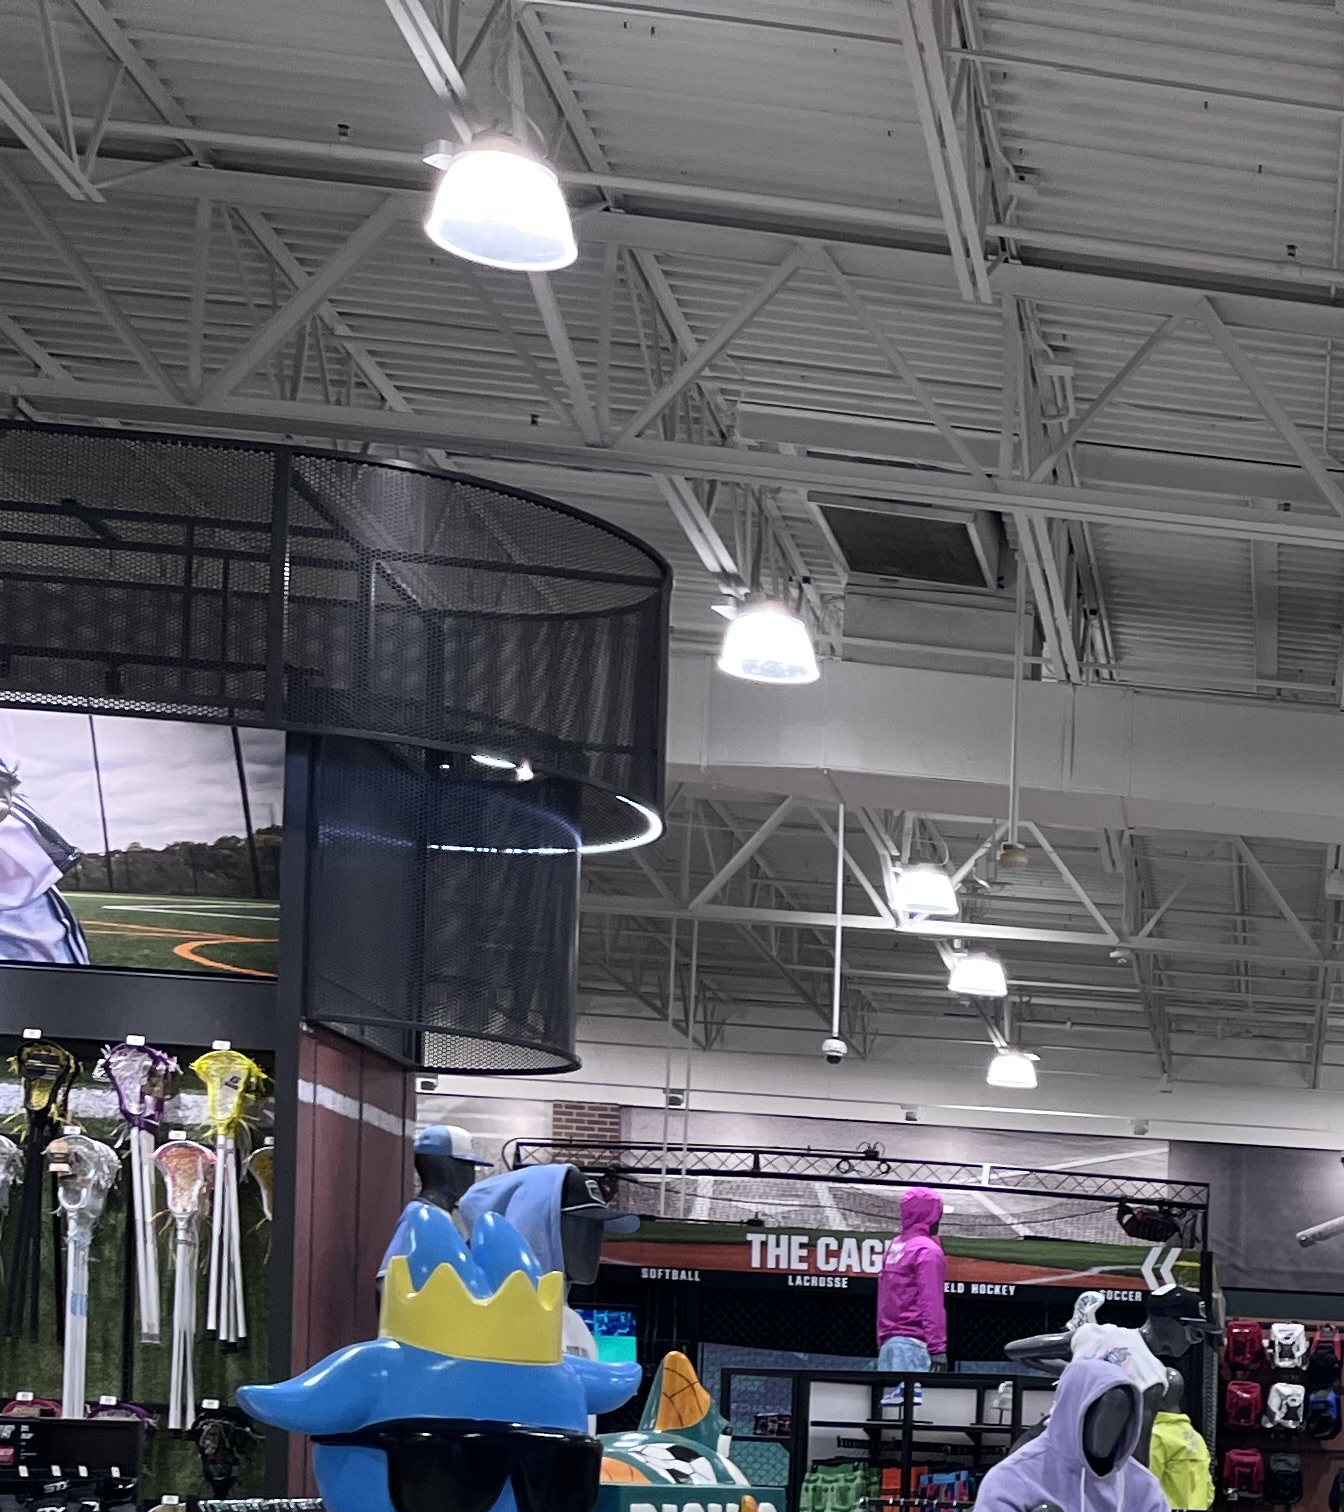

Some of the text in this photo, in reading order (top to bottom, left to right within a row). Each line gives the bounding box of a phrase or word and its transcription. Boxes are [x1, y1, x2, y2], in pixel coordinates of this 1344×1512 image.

[746, 1233, 809, 1270] THE
[817, 1236, 890, 1274] CAG
[641, 1267, 701, 1282] SOFTBALL
[788, 1275, 849, 1289] LACROSSE
[971, 1284, 1016, 1296] HOCKEY
